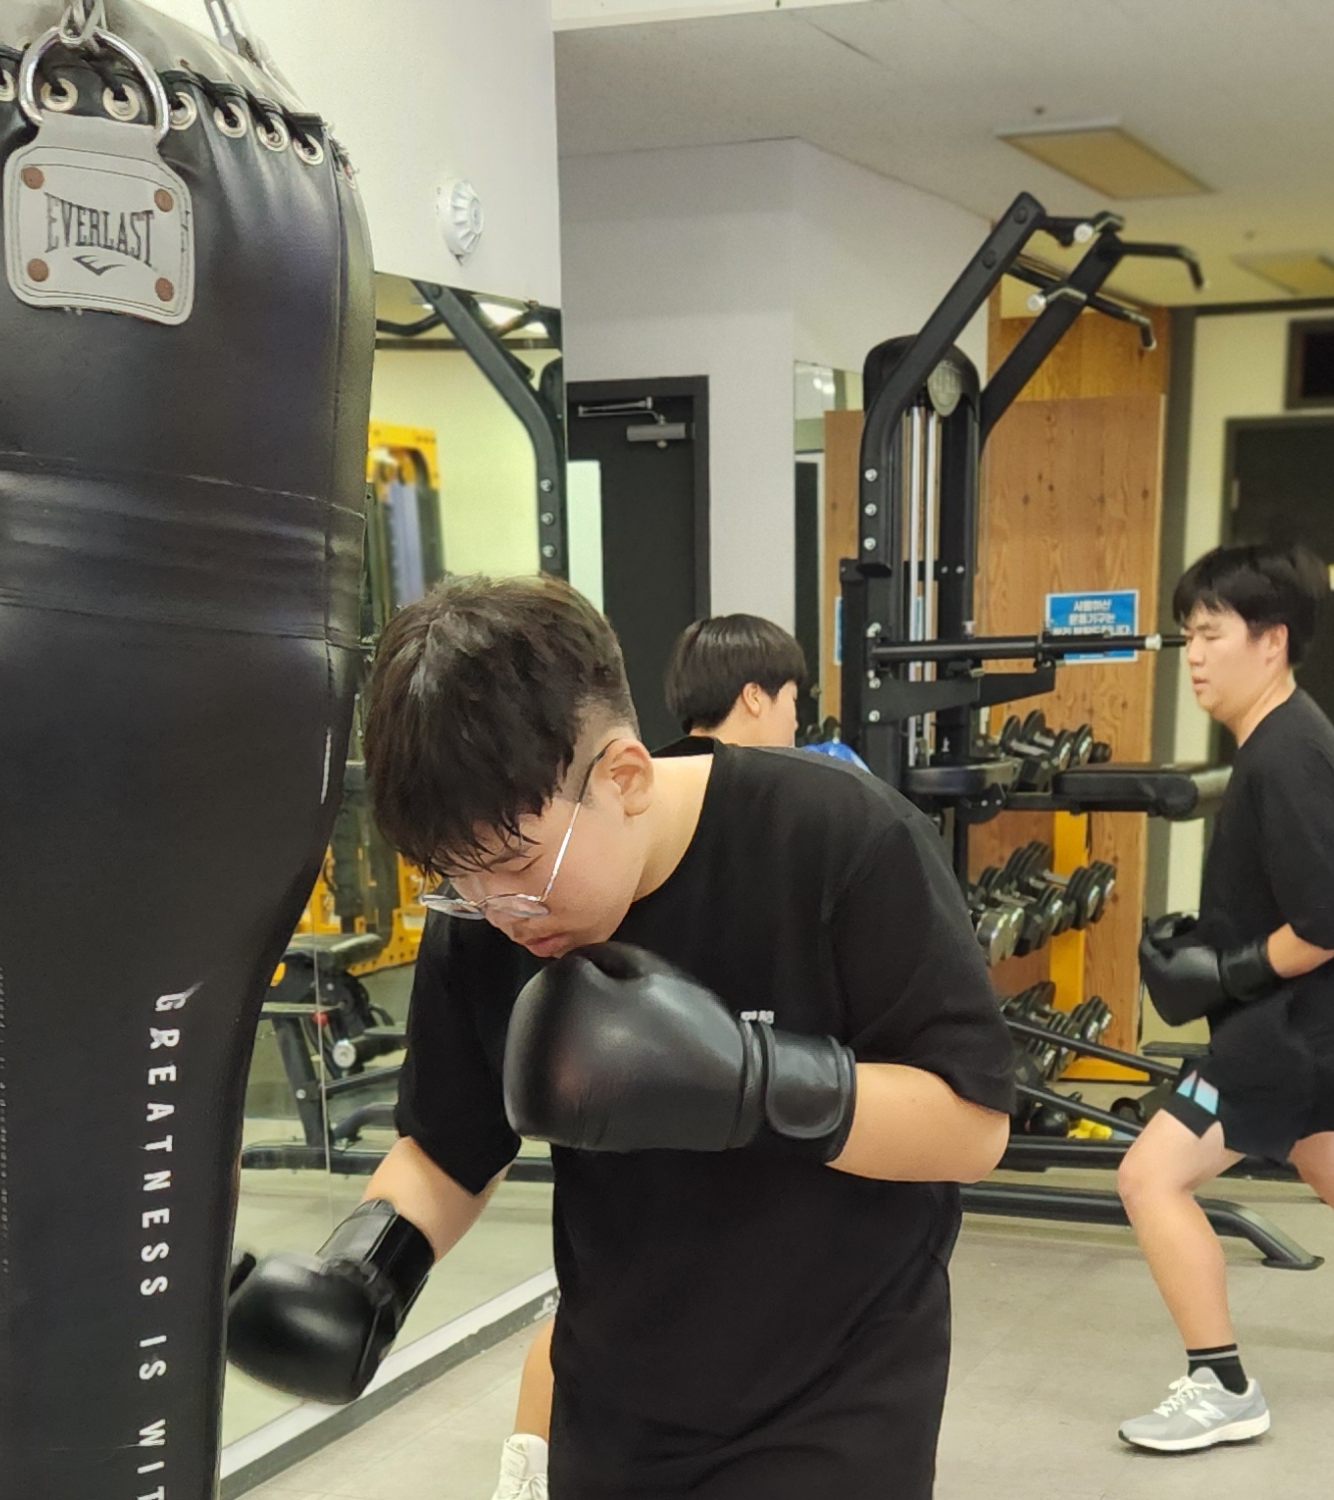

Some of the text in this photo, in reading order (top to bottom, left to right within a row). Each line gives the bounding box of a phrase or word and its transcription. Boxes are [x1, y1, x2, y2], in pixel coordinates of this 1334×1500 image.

[44, 191, 155, 268] EVERLAST
[140, 991, 186, 1297] GREATNESS
[139, 1334, 166, 1381] IS
